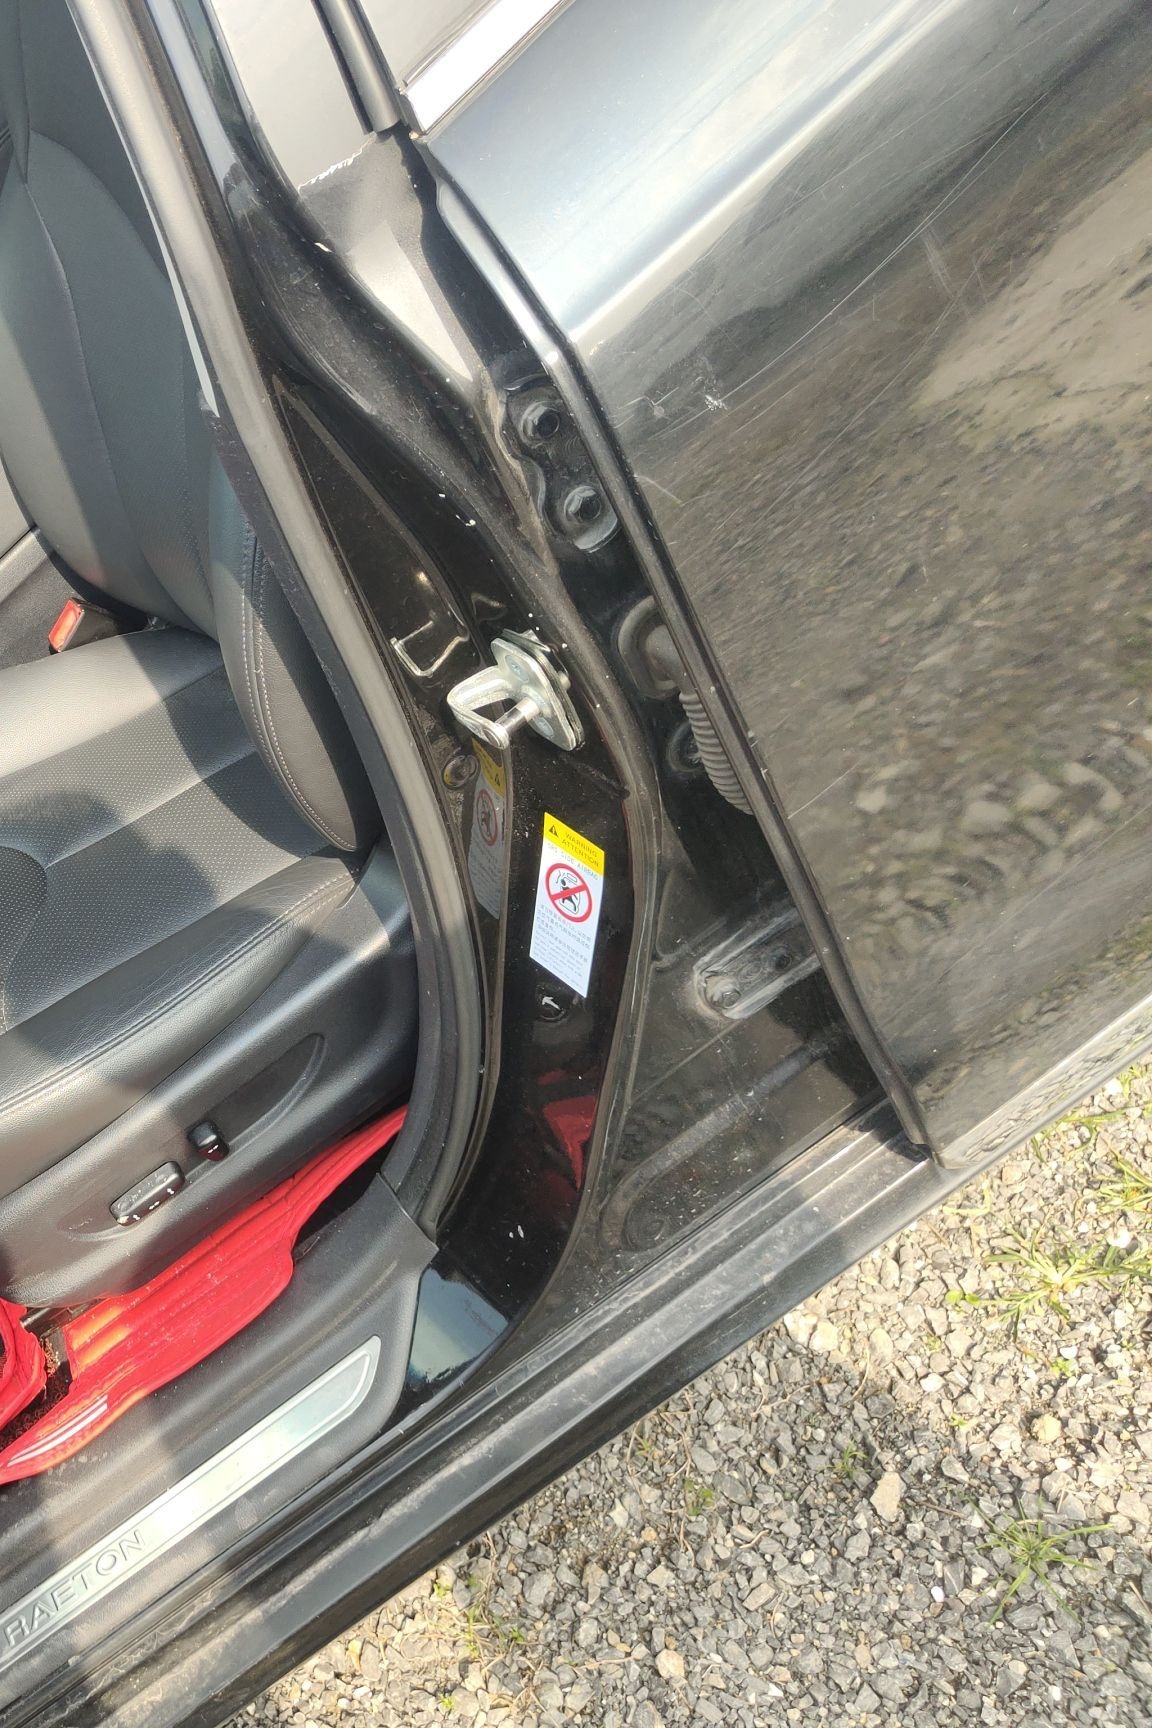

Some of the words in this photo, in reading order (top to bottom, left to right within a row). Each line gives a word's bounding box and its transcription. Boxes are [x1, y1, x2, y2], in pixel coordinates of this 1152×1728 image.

[561, 839, 600, 868] ATTENTION
[565, 832, 598, 858] WARNING
[4, 1531, 146, 1647] RAETON
